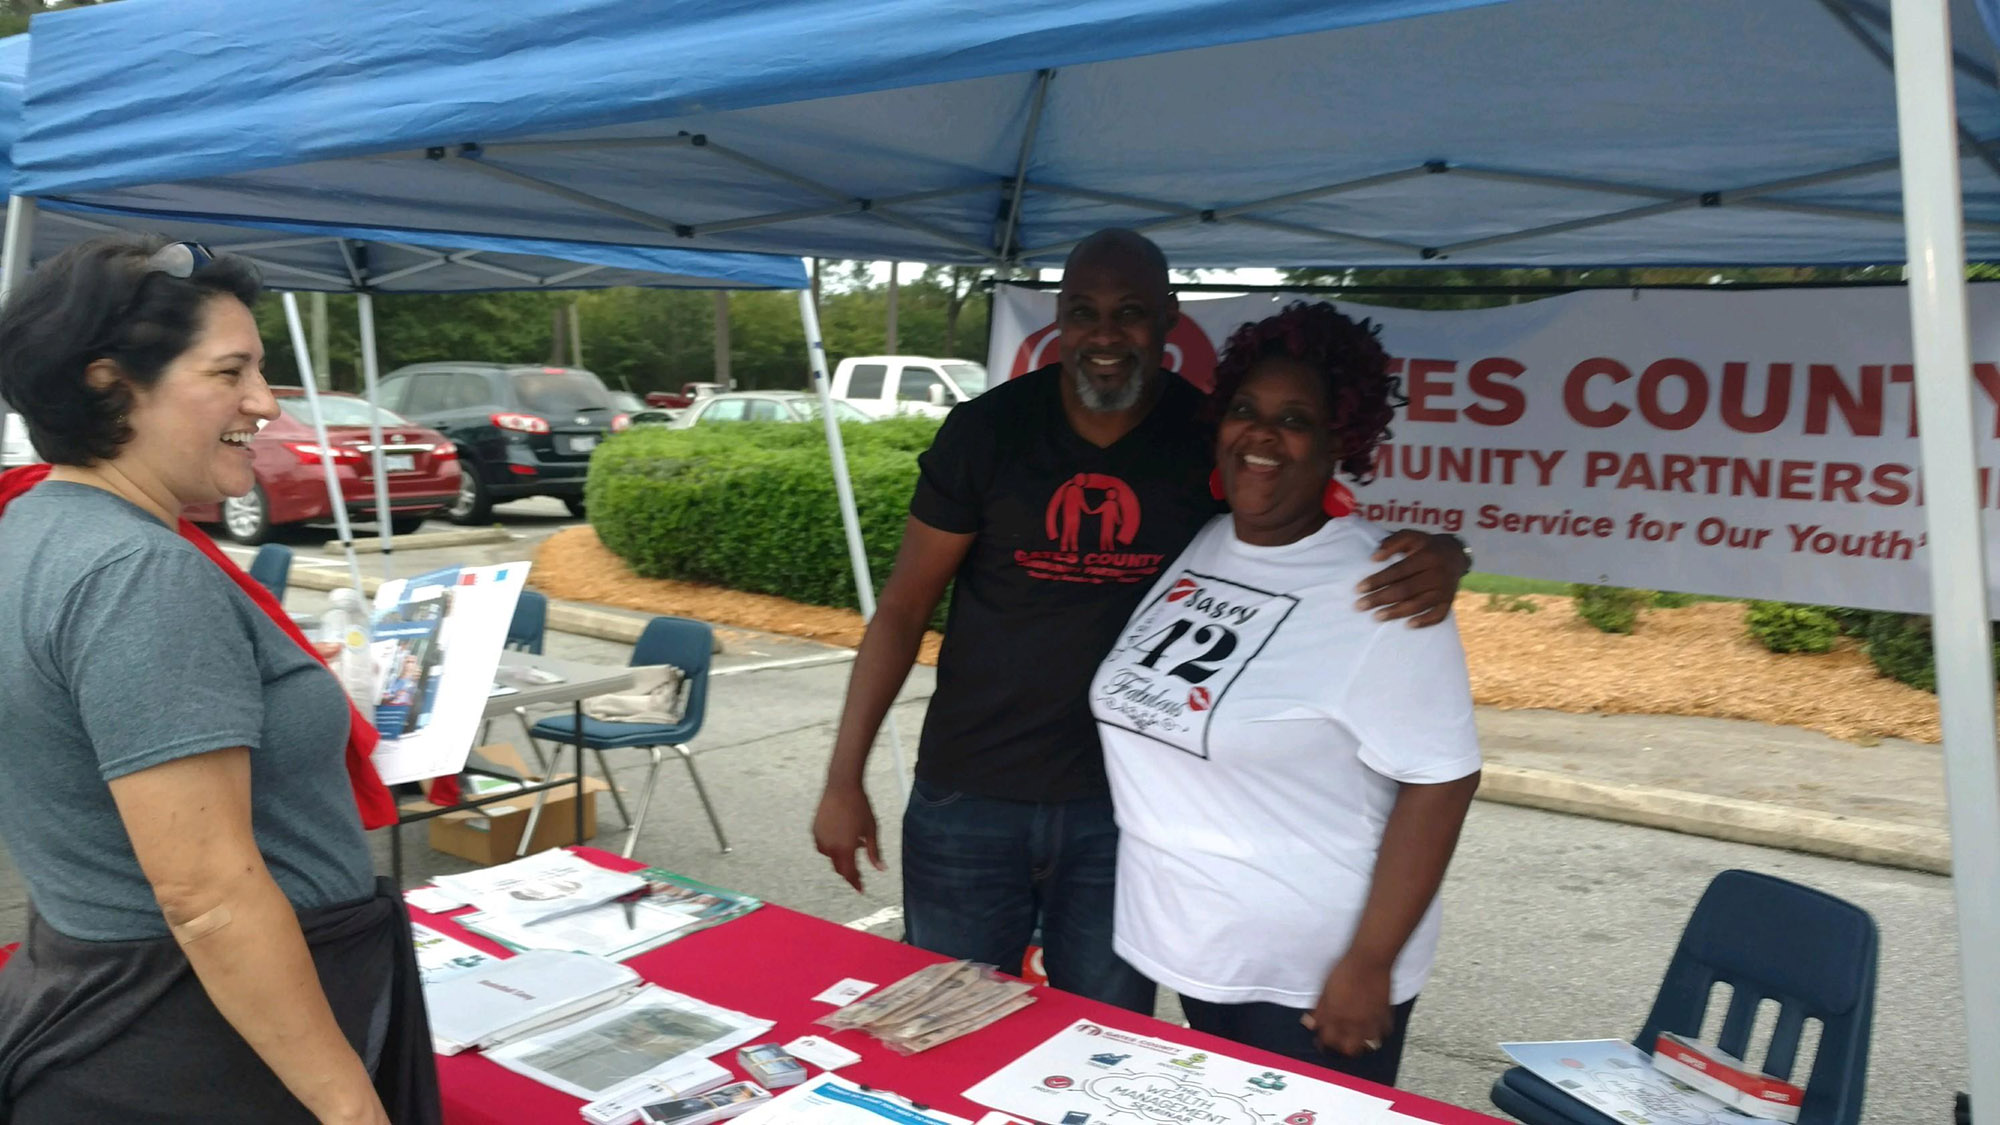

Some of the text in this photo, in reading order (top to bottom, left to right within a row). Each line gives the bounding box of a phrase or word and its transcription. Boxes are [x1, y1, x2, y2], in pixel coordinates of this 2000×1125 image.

[1584, 451, 2000, 509] PARTNERSI
[1476, 504, 1615, 538] Service
[1625, 512, 1687, 542] for
[1696, 516, 1774, 550] Our
[1083, 553, 1165, 567] COUNTY
[1131, 618, 1238, 684] 42
[1110, 1086, 1231, 1124] MANAGEMENT
[1130, 1101, 1193, 1124] SEMINAR
[1146, 1083, 1216, 1110] WEALTH
